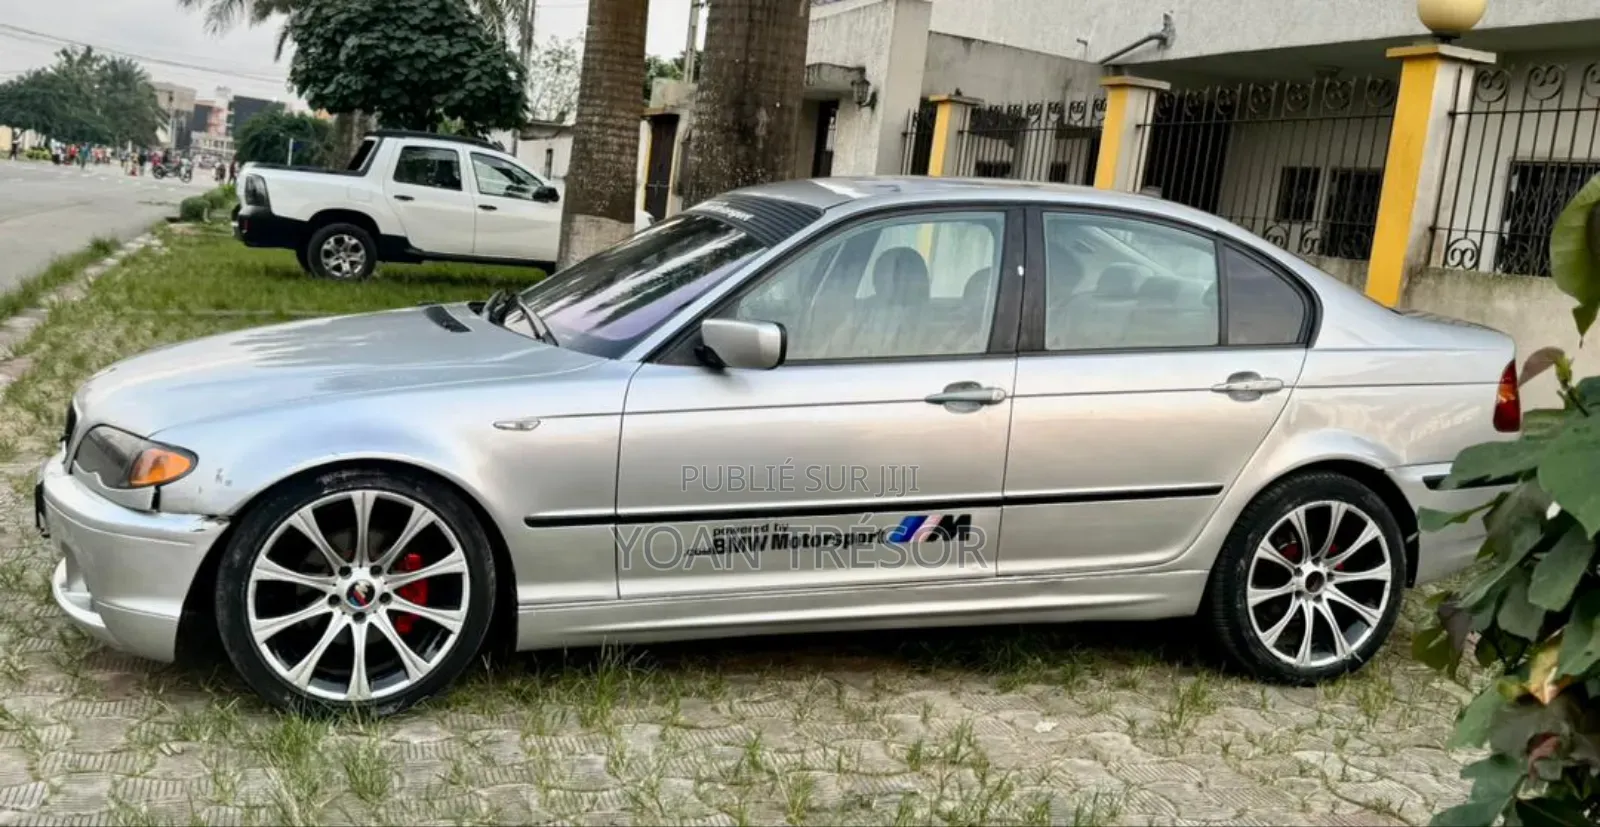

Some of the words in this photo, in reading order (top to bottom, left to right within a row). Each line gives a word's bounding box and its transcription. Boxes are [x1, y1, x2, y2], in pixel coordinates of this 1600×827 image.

[713, 523, 769, 537] powered
[714, 534, 768, 554] BMW
[771, 527, 886, 550] Motorsport
